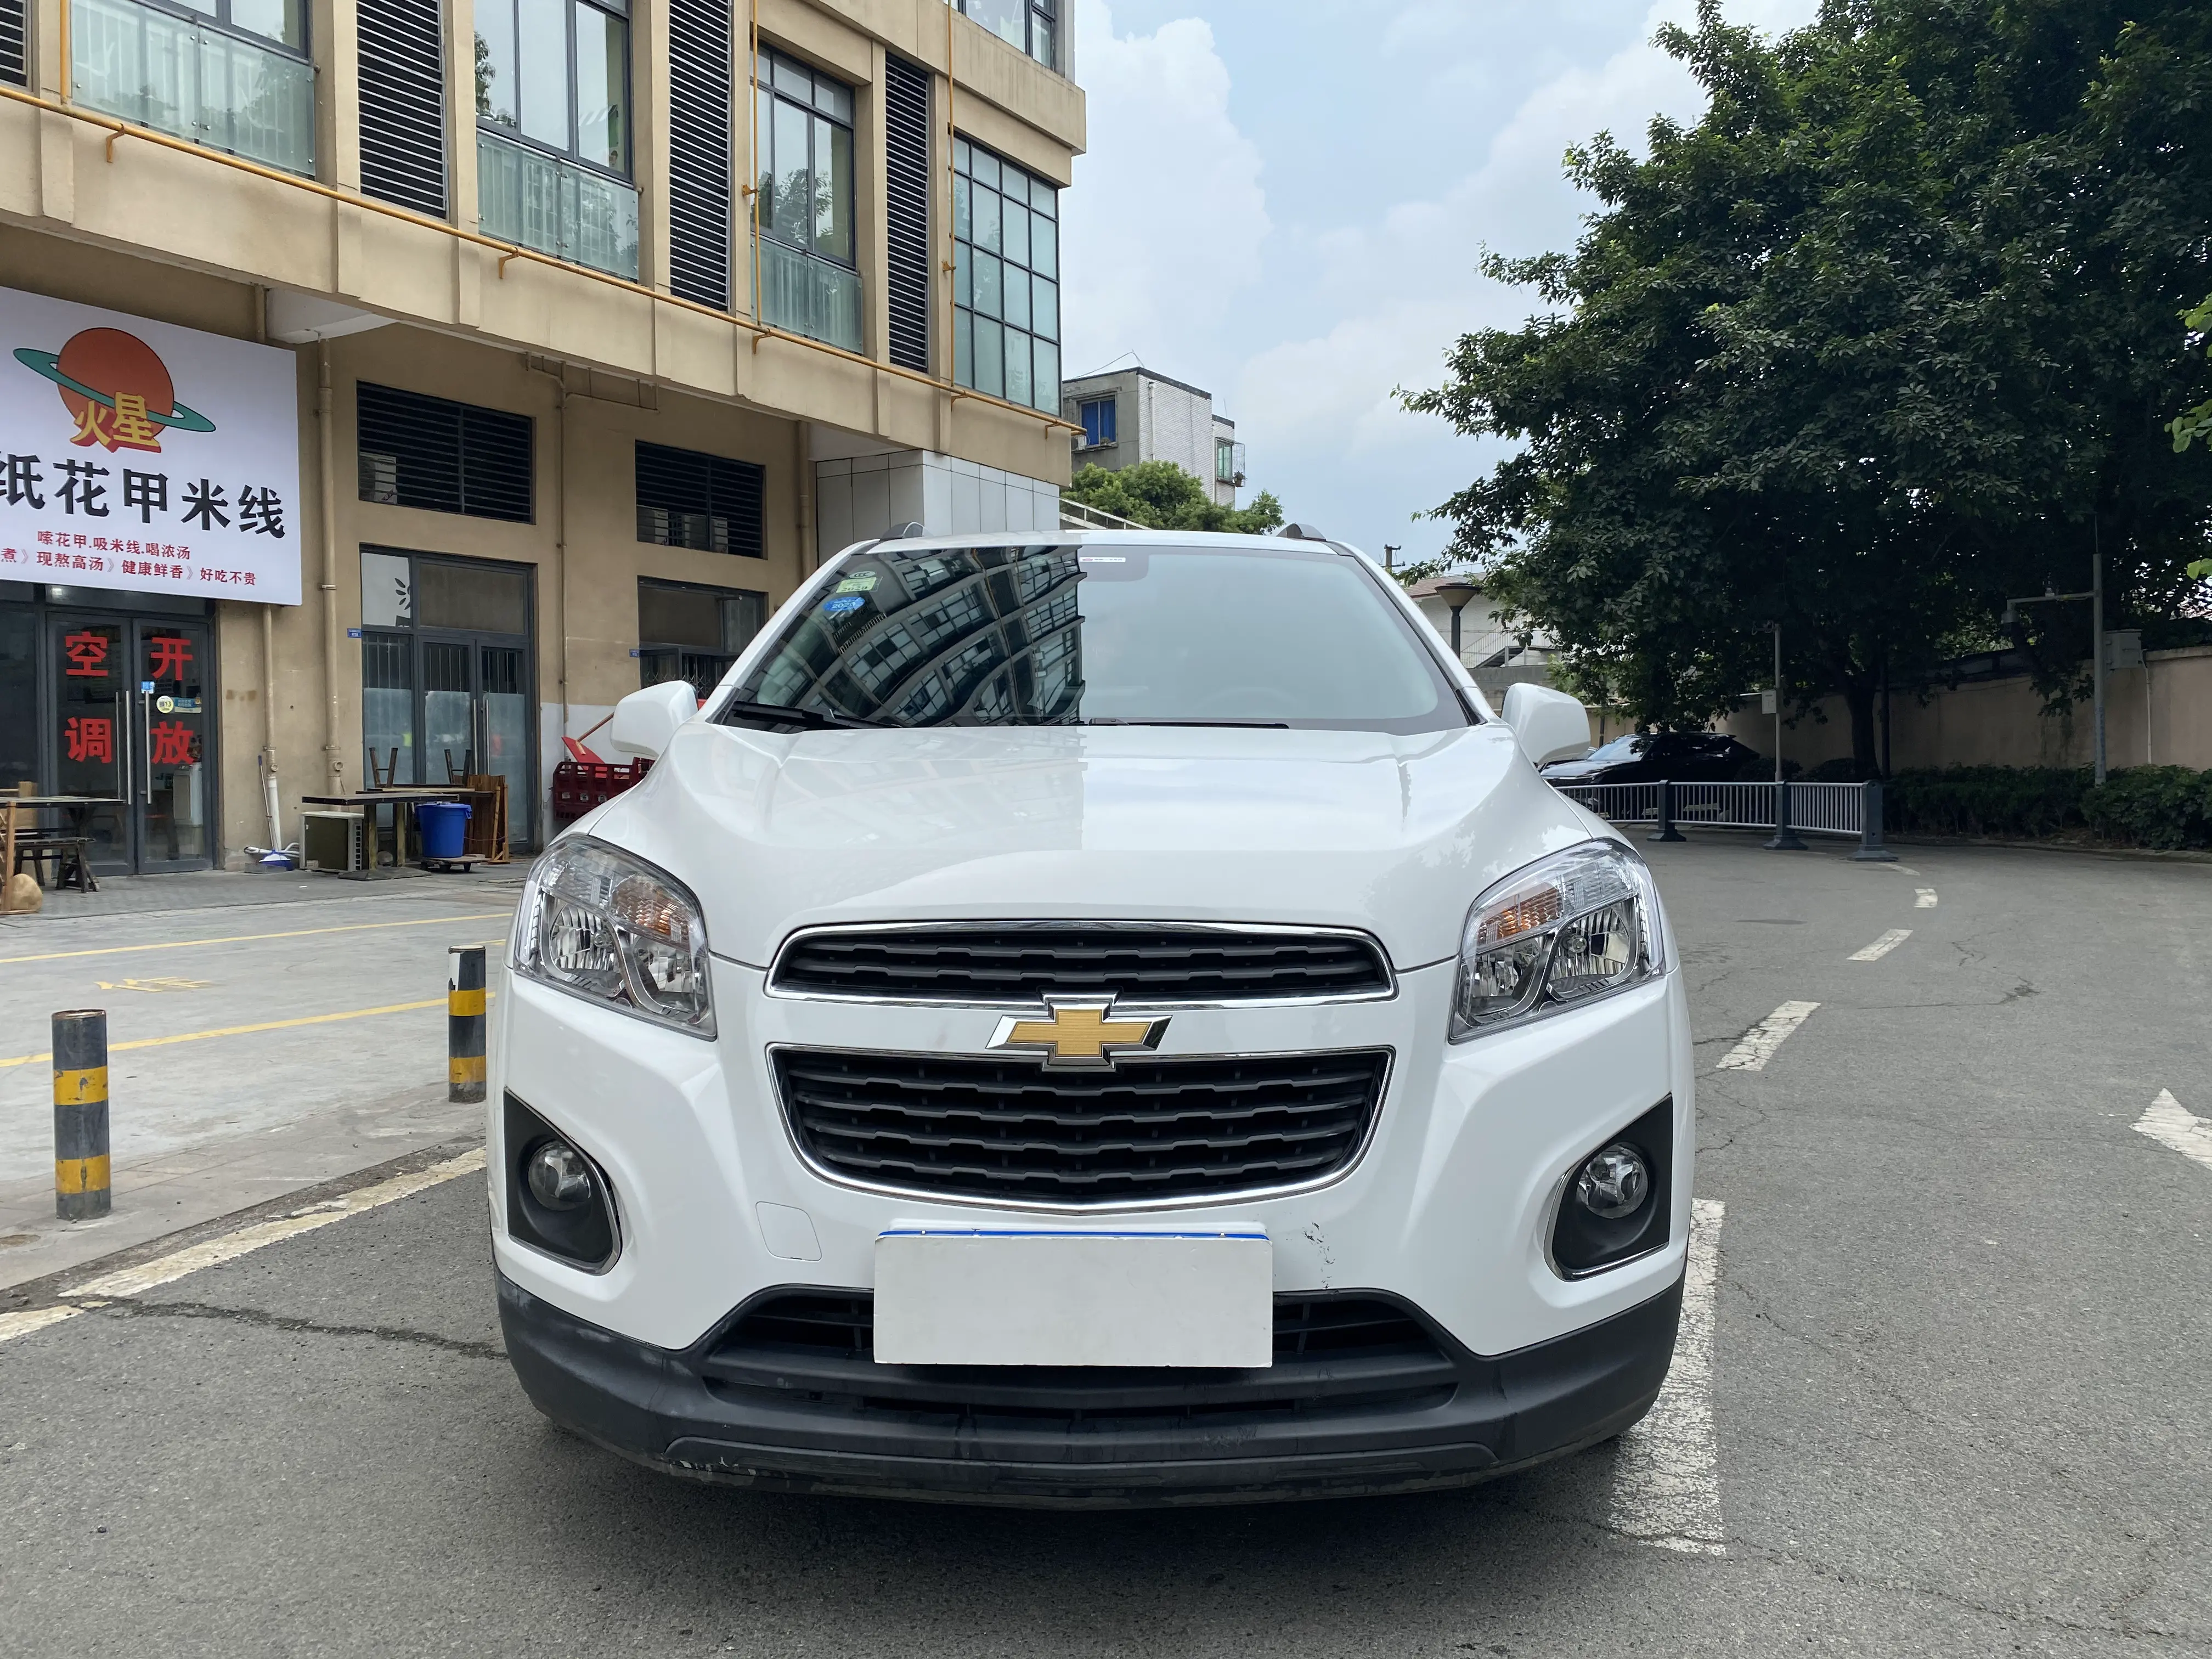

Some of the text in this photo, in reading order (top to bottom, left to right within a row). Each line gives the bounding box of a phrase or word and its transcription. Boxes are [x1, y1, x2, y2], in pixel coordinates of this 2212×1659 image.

[70, 391, 162, 453] 火星
[0, 451, 285, 539] 纸花甲米线
